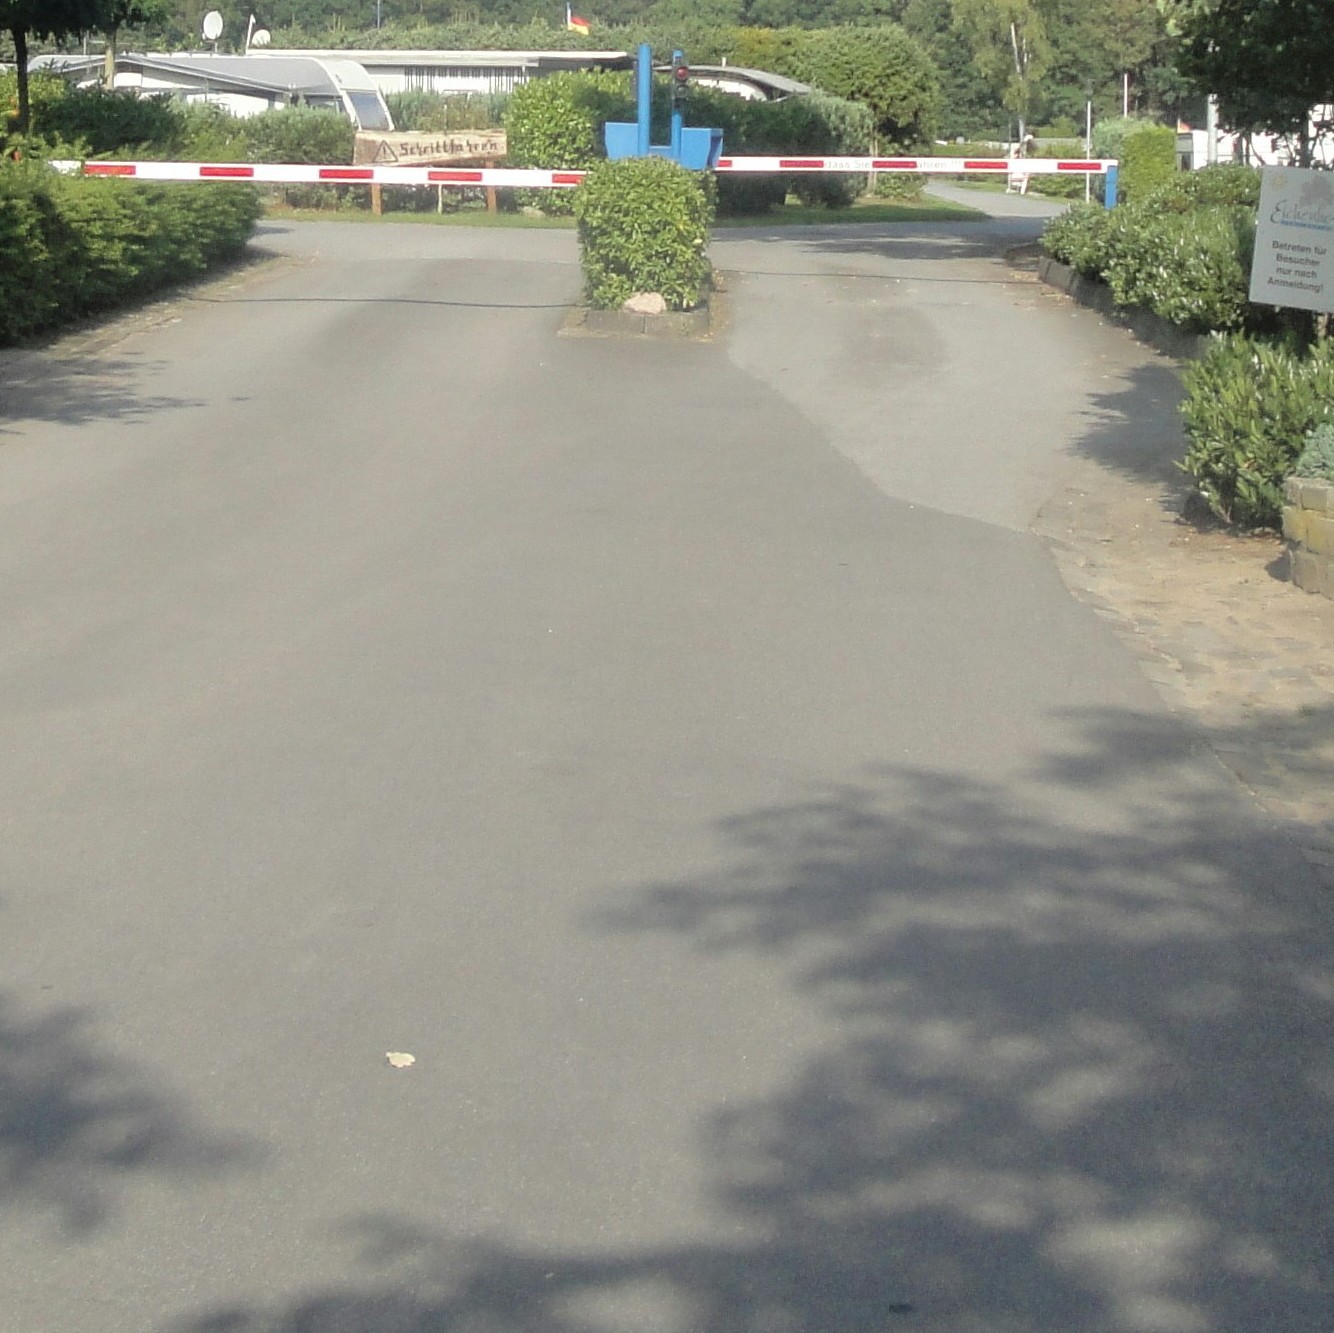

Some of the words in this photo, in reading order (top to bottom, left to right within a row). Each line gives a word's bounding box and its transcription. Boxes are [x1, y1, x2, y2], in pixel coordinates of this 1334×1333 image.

[1272, 240, 1312, 254] Betreten
[1314, 246, 1327, 255] für
[1276, 253, 1321, 266] Besucher
[1276, 267, 1292, 275] nur
[1294, 269, 1318, 279] nach
[1267, 276, 1324, 293] Anmeldung!
